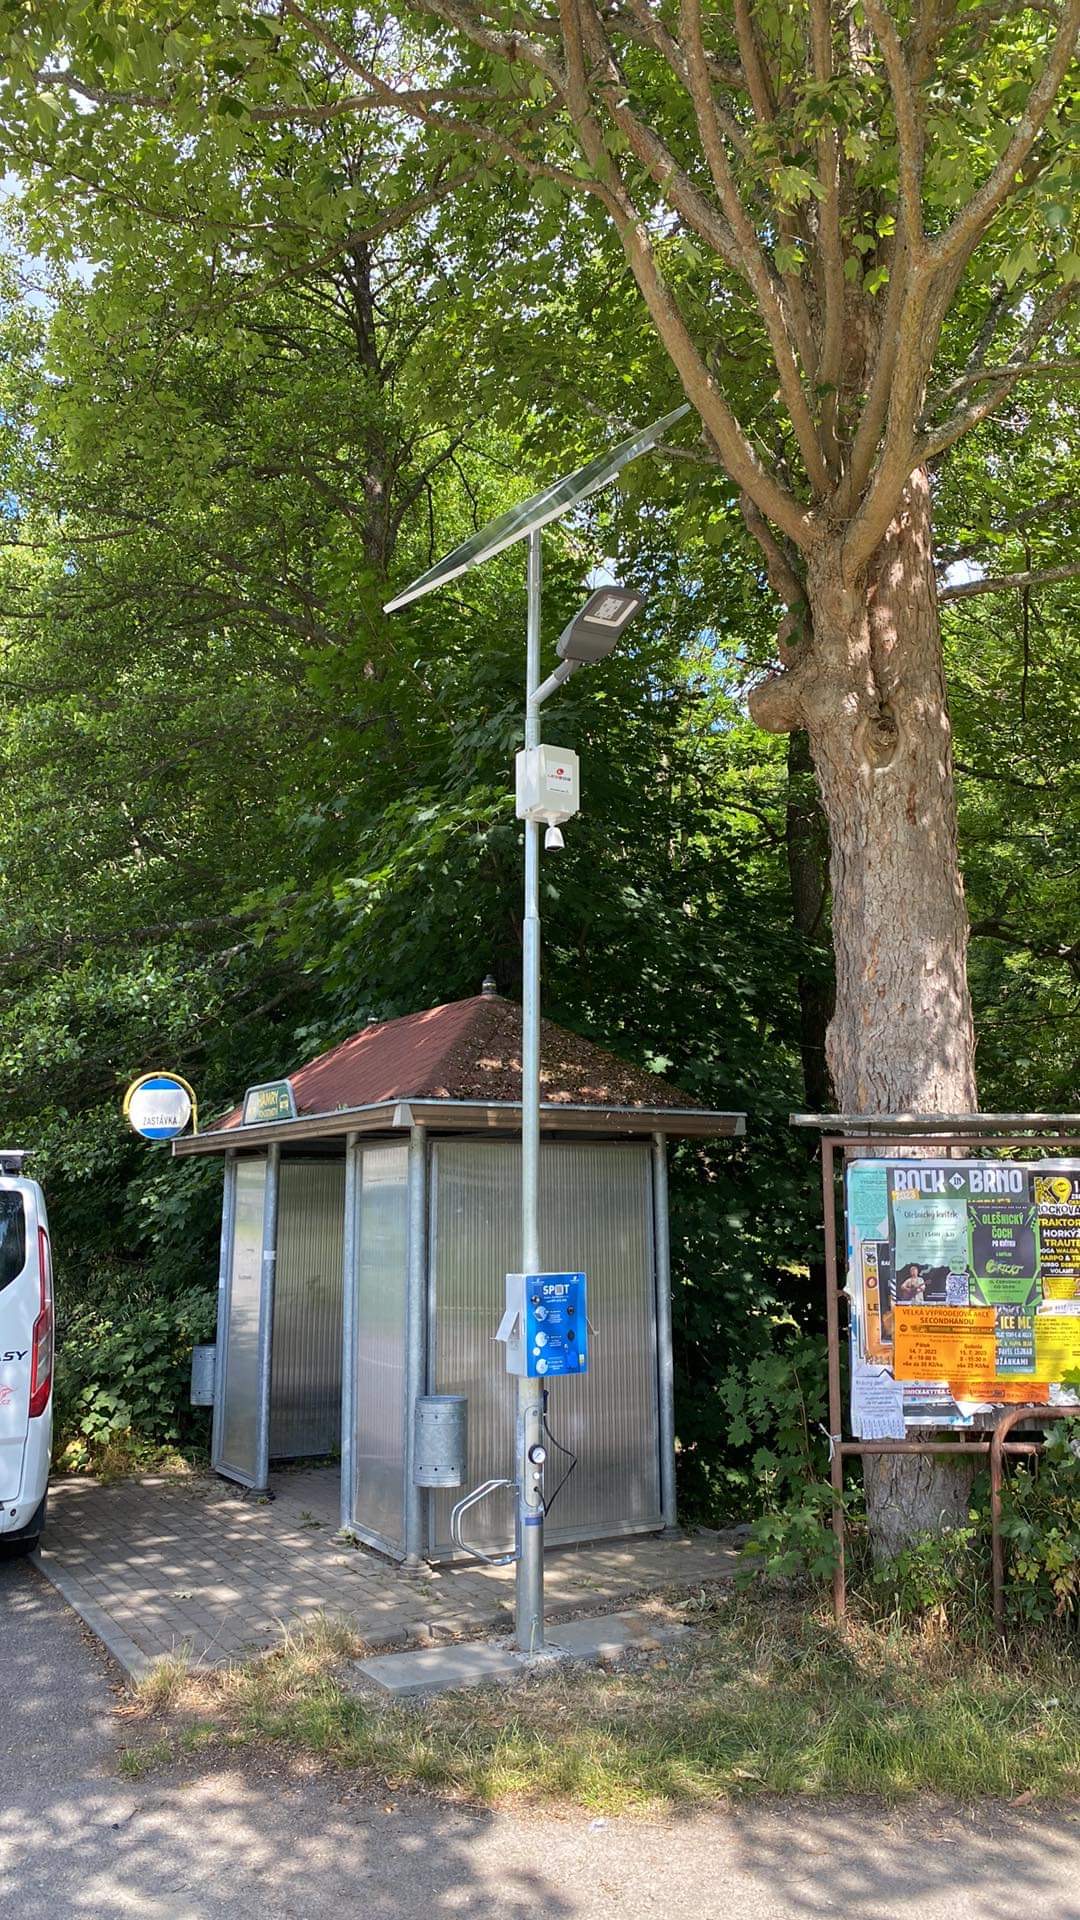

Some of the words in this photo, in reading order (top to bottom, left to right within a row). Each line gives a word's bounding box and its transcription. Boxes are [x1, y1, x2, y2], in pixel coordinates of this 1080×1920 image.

[143, 1114, 178, 1126] ZASTÁVKA
[893, 1169, 946, 1192] ROCK
[969, 1169, 1023, 1193] BRNO
[982, 1211, 1024, 1225] OLEŠNICKÝ
[543, 1284, 570, 1295] SPOT
[920, 1316, 974, 1325] SECONDHANDU
[1000, 1315, 1015, 1329] ICE
[0, 1350, 28, 1361] SY
